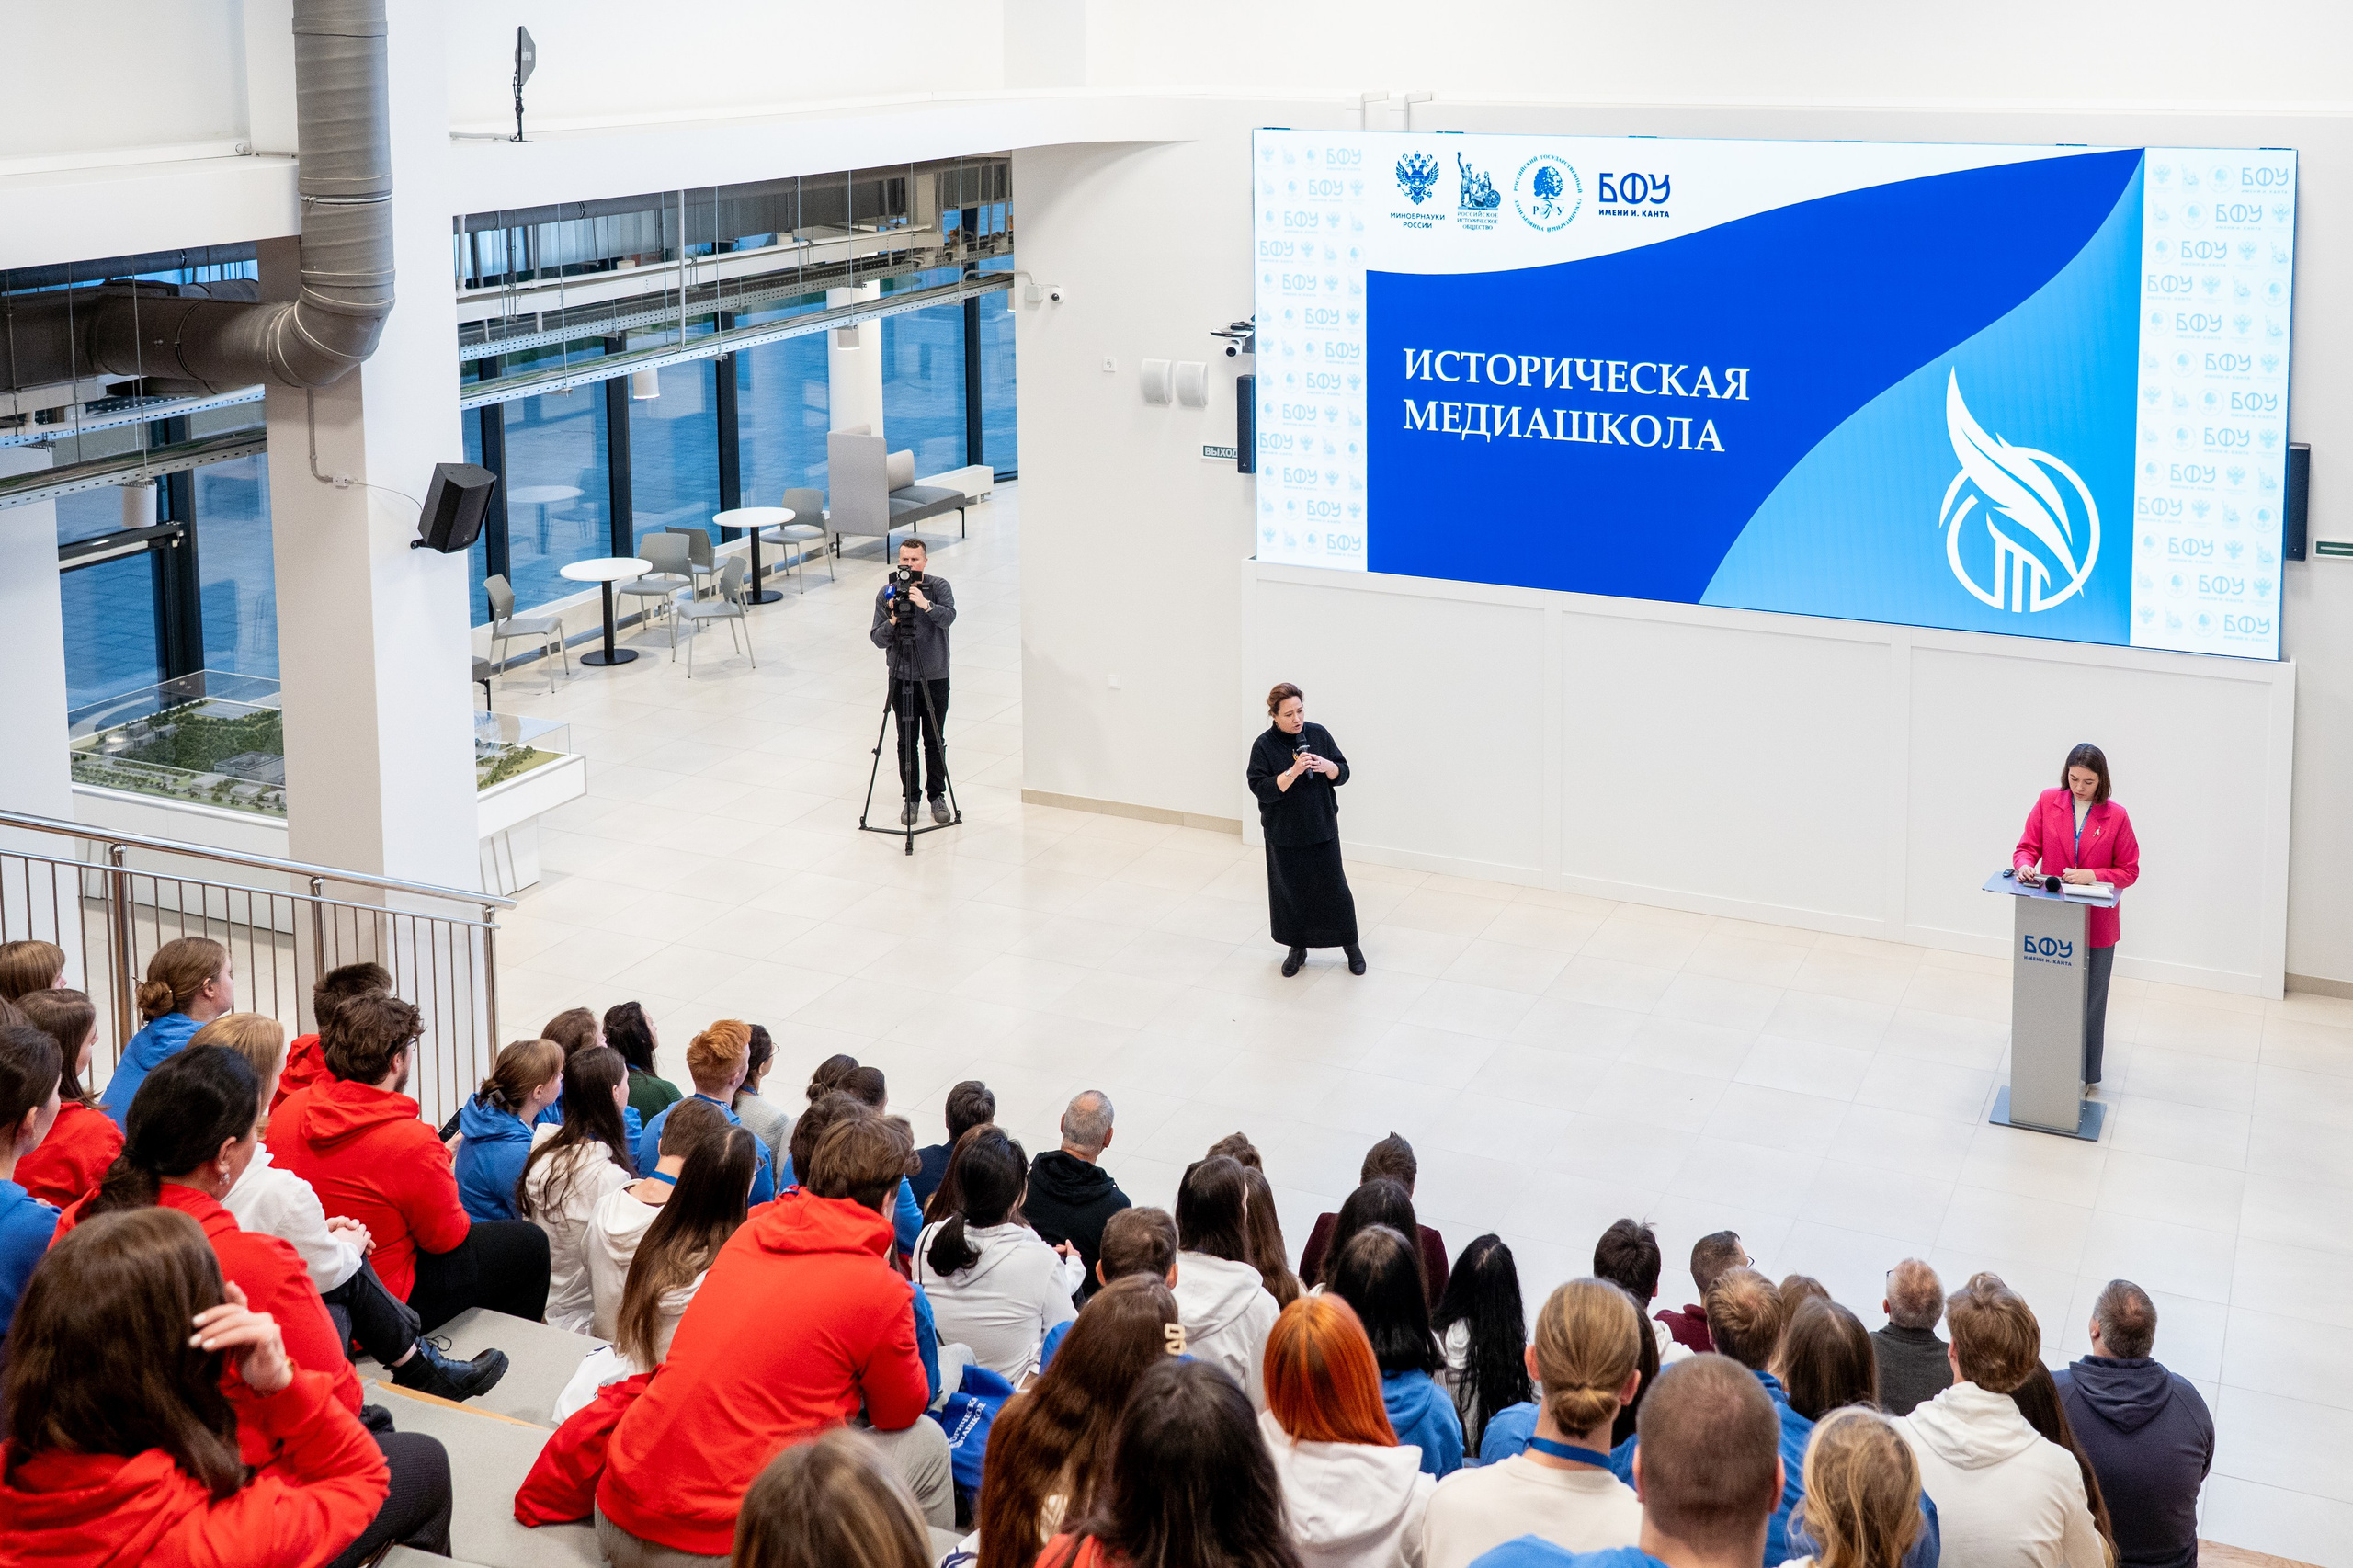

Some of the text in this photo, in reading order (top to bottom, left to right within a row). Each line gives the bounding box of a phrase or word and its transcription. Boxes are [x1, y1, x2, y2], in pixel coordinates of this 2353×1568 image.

[1326, 148, 1361, 165] БФУ
[2242, 167, 2289, 187] БФУ
[1309, 179, 1343, 196] БФУ
[1599, 172, 1671, 205] БФУ
[1284, 211, 1319, 228] БФУ
[1390, 212, 1446, 221] МИНОБРНАУКИ
[1598, 209, 1629, 217] ИМЕНИ
[1642, 210, 1670, 218] КАНТА
[2216, 204, 2262, 222] БФУ
[1260, 240, 1294, 257] БФУ
[2181, 241, 2227, 259] БФУ
[1282, 273, 1317, 290] БФУ
[2147, 275, 2193, 293] БФУ
[1305, 308, 1339, 324] БФУ
[2177, 313, 2222, 333] БФУ
[1325, 342, 1360, 358] БФУ
[2205, 353, 2251, 372] БФУ
[1307, 372, 1341, 390] БФУ
[1403, 347, 1750, 401] ИСТОРИЧЕСКАЯ
[2231, 392, 2278, 412] БФУ
[1282, 403, 1317, 421] БФУ
[1403, 399, 1725, 452] МЕДИАШКОЛА
[1259, 432, 1293, 449] БФУ
[2204, 427, 2250, 448] БФУ
[1204, 447, 1238, 458] ВЫХОД
[1283, 467, 1318, 484] БФУ
[2170, 463, 2216, 483] БФУ
[1307, 500, 1341, 517] БФУ
[2138, 496, 2183, 517] БФУ
[1327, 534, 1361, 551] БФУ
[2168, 537, 2214, 557] БФУ
[2199, 574, 2245, 596] БФУ
[2224, 614, 2270, 635] БФУ
[2024, 935, 2073, 959] БФУ
